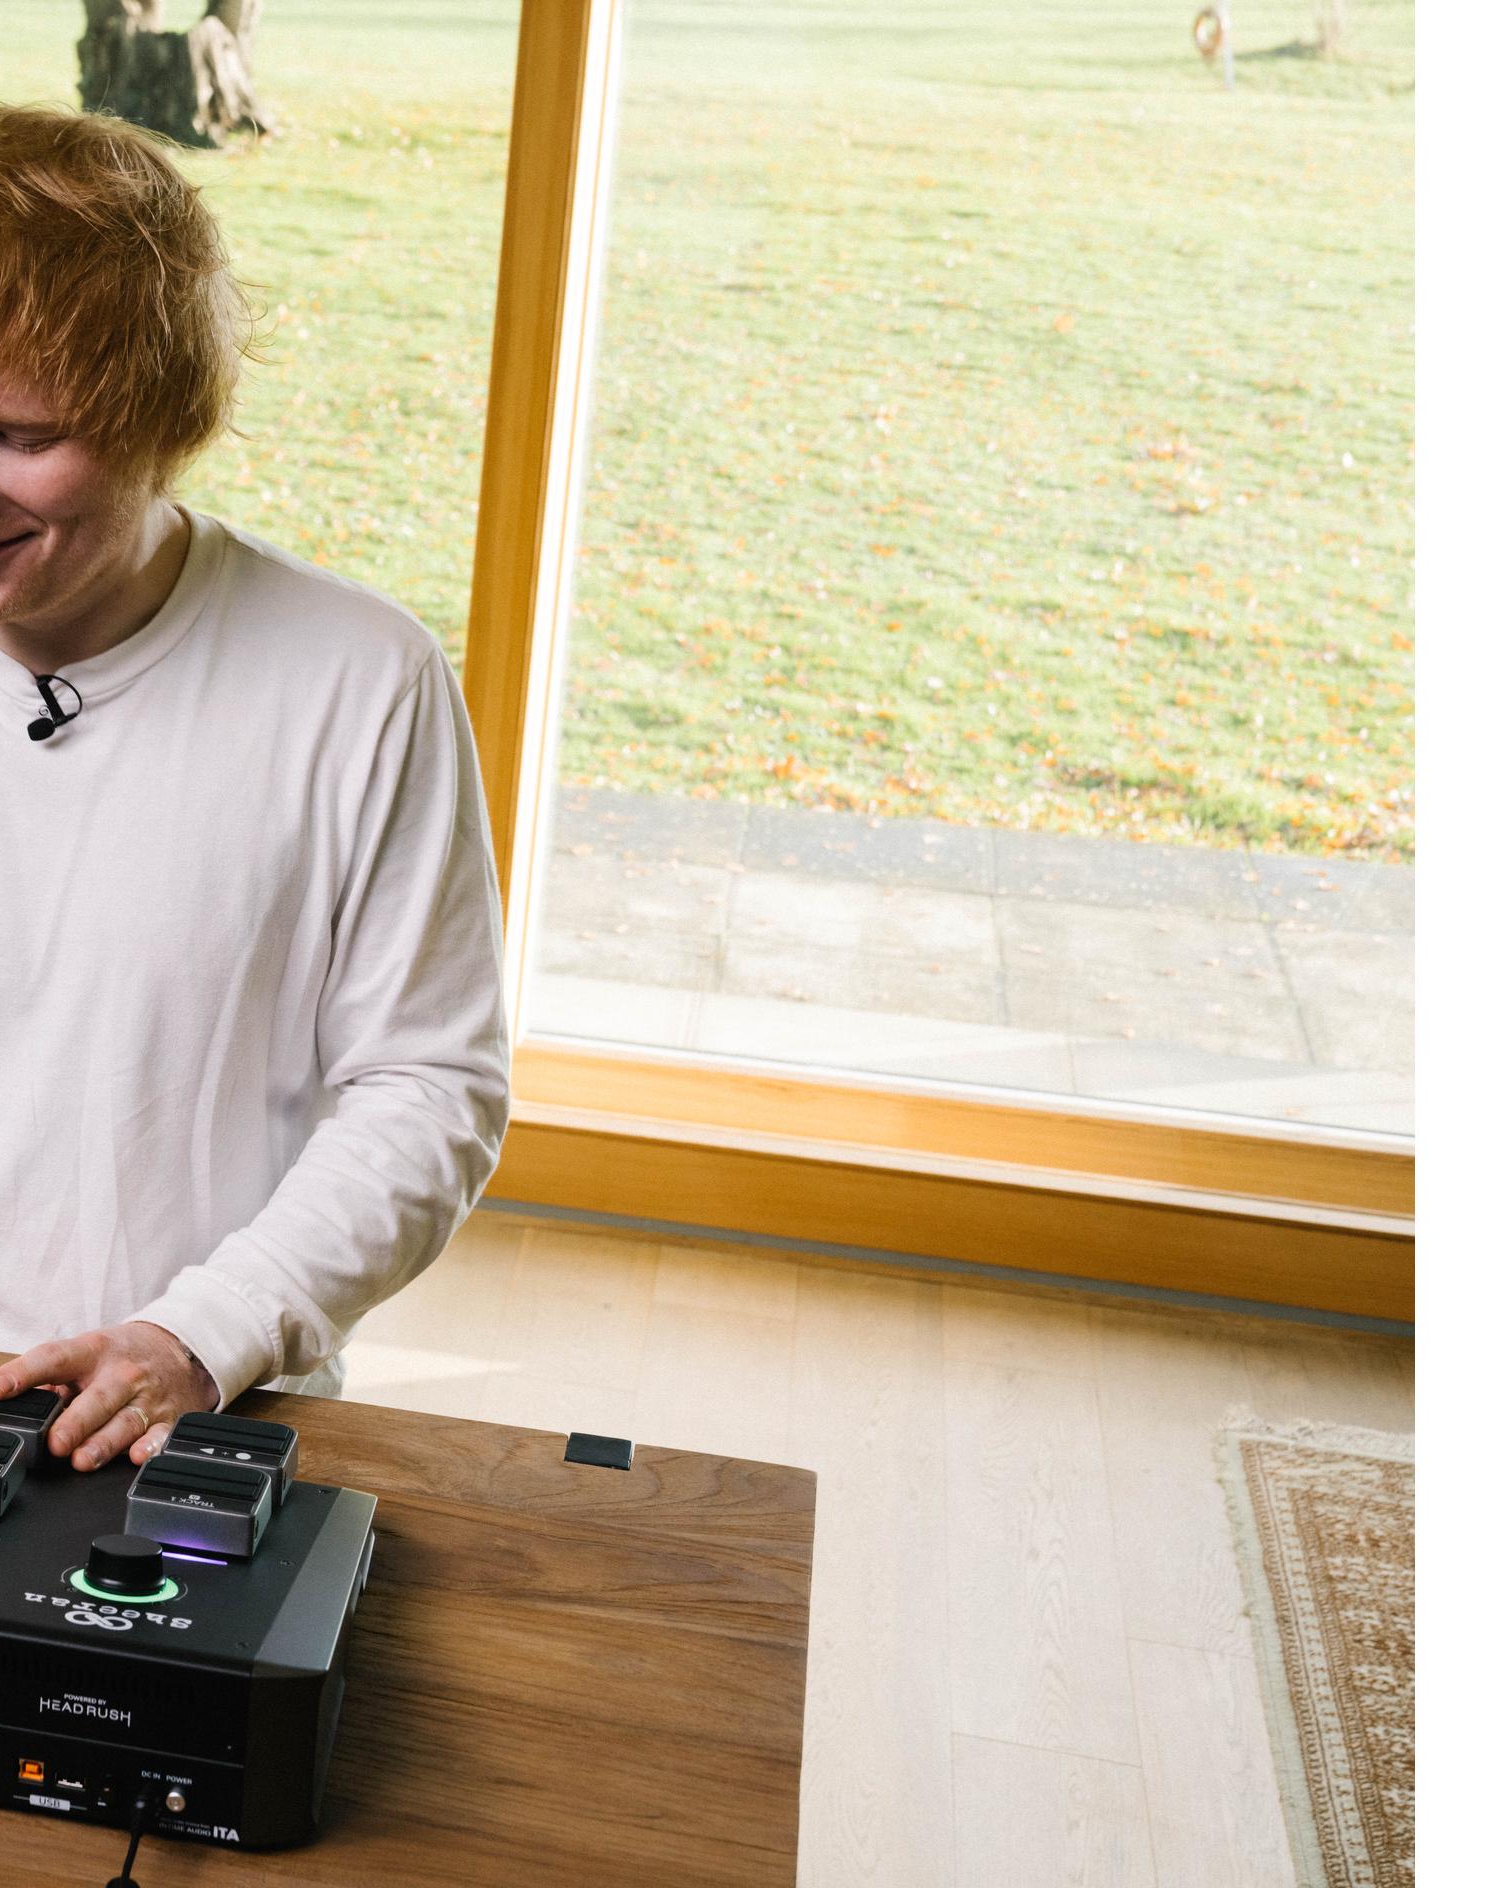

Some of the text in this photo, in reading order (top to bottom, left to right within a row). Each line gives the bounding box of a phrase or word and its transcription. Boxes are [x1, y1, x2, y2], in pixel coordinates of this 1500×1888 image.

[179, 1497, 215, 1508] TRACK
[24, 1592, 193, 1629] Sheeran
[63, 1693, 96, 1705] POWERED
[141, 1770, 161, 1780] DC IN
[166, 1775, 193, 1785] POWER
[39, 1797, 61, 1809] USB
[213, 1826, 240, 1842] ITA
